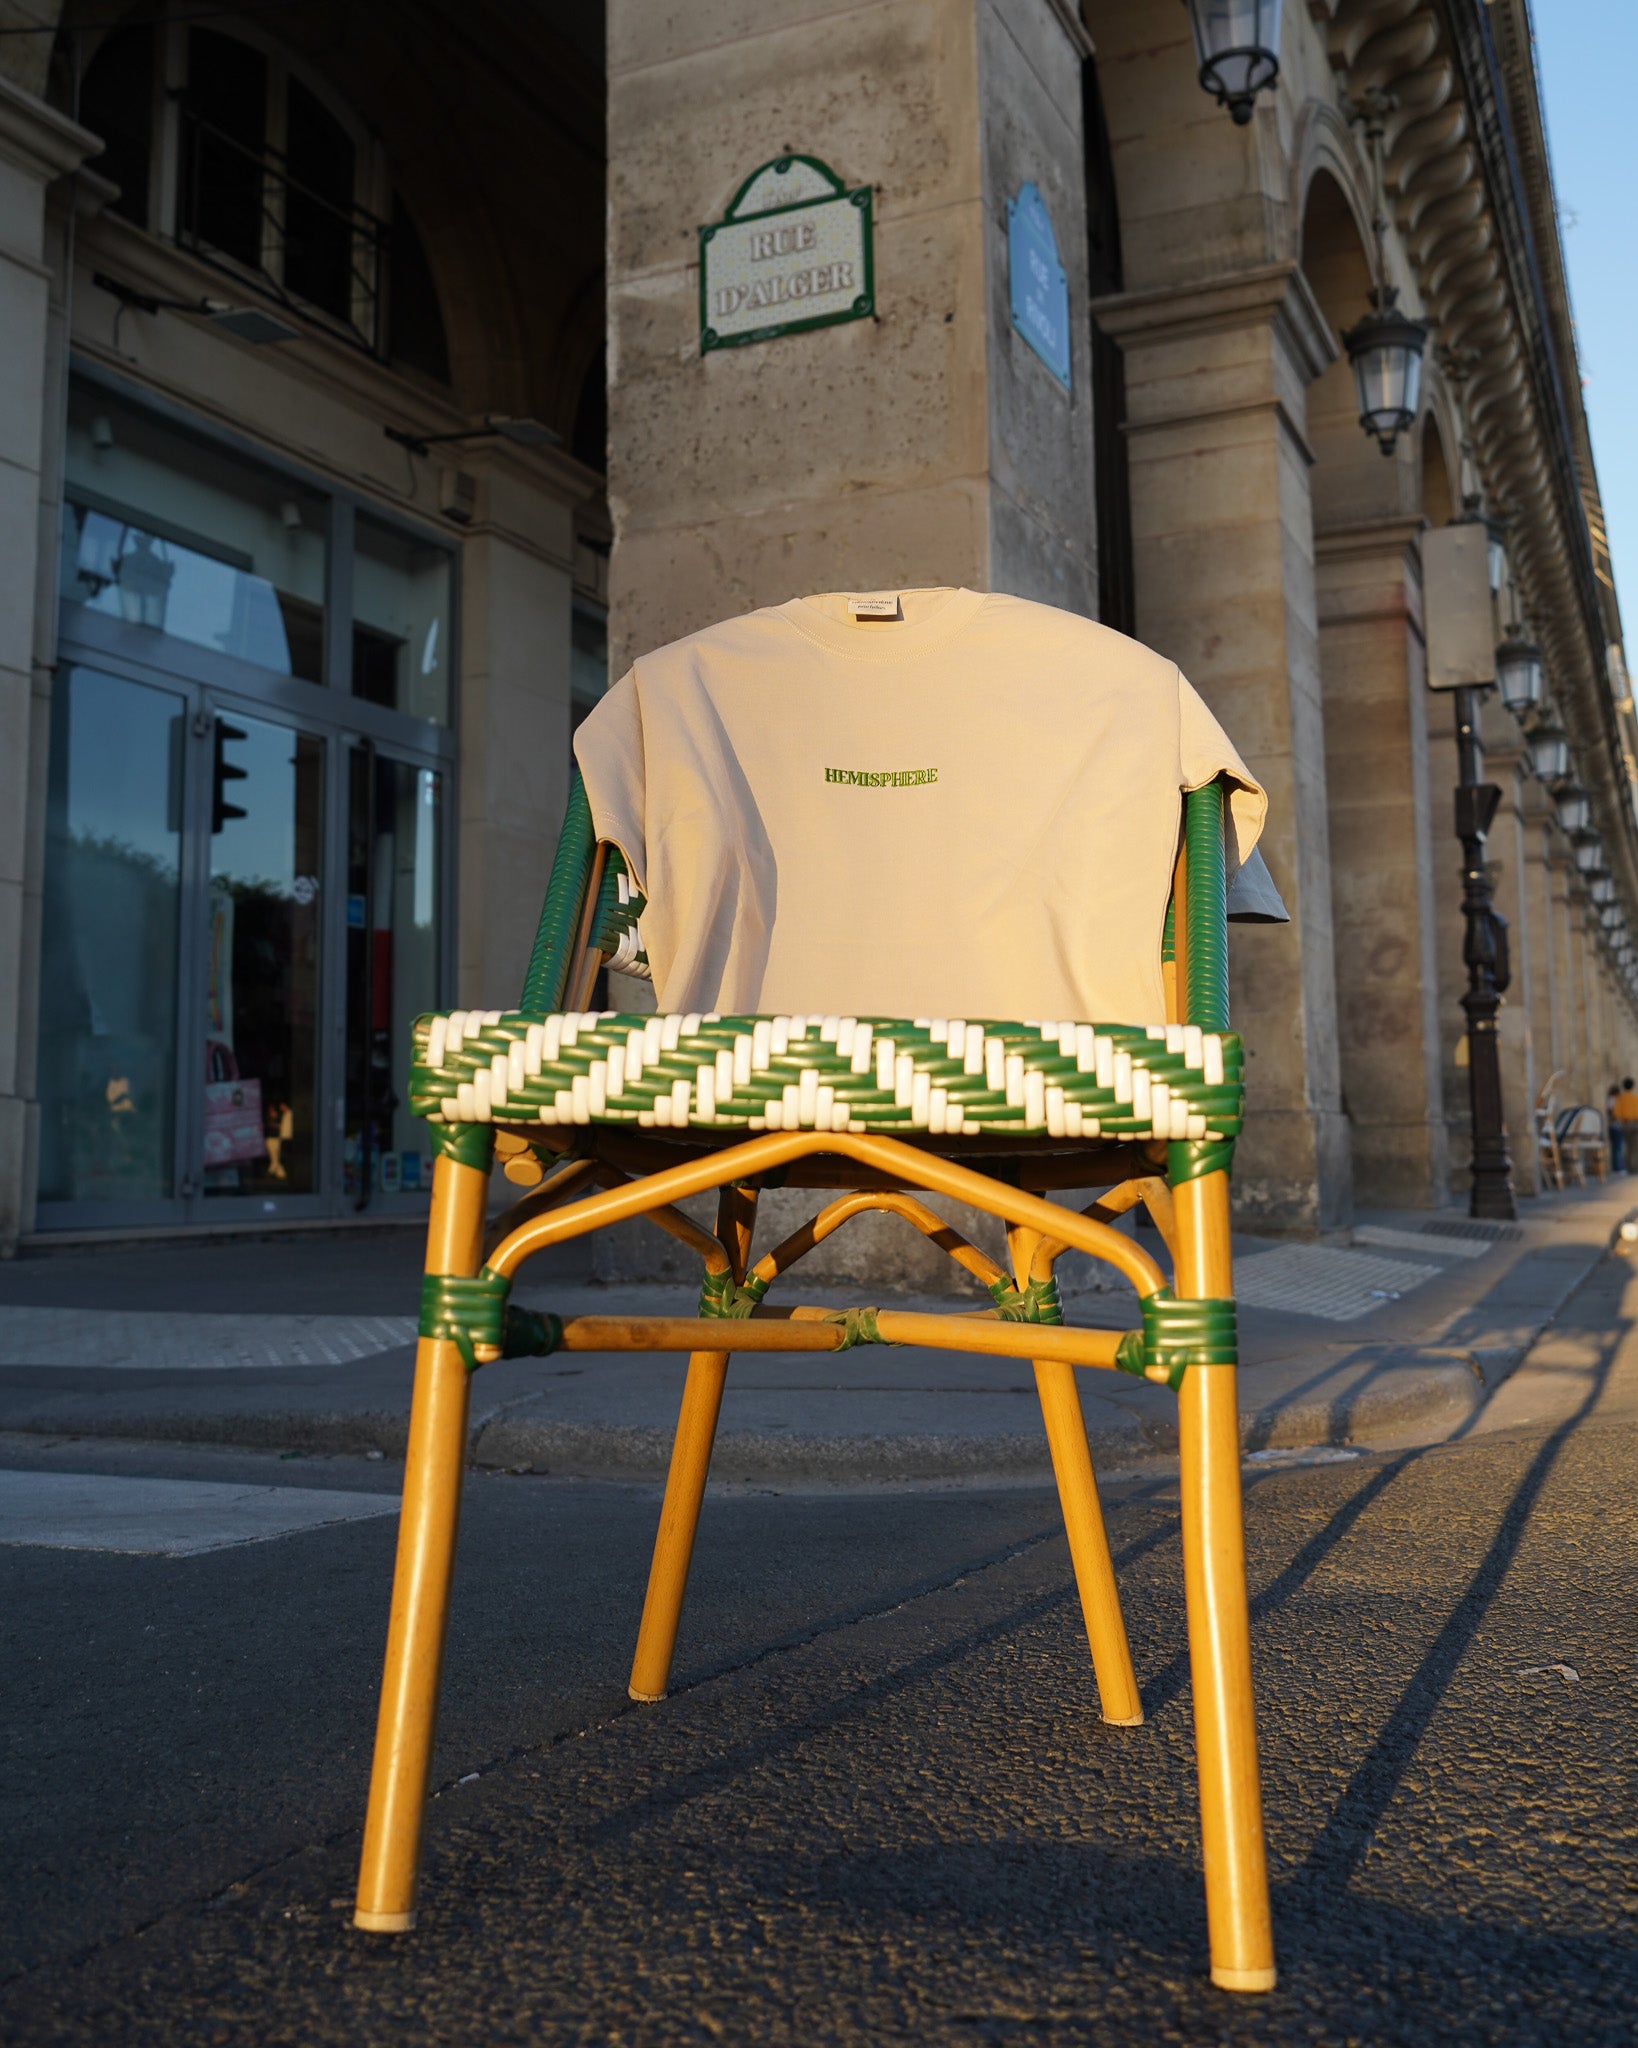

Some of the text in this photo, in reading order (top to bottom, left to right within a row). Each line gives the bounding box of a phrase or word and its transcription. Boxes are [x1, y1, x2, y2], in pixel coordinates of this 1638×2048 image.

[752, 223, 816, 262] RUE
[716, 262, 853, 316] D'ALGER
[824, 767, 938, 787] HEMISPHERE
